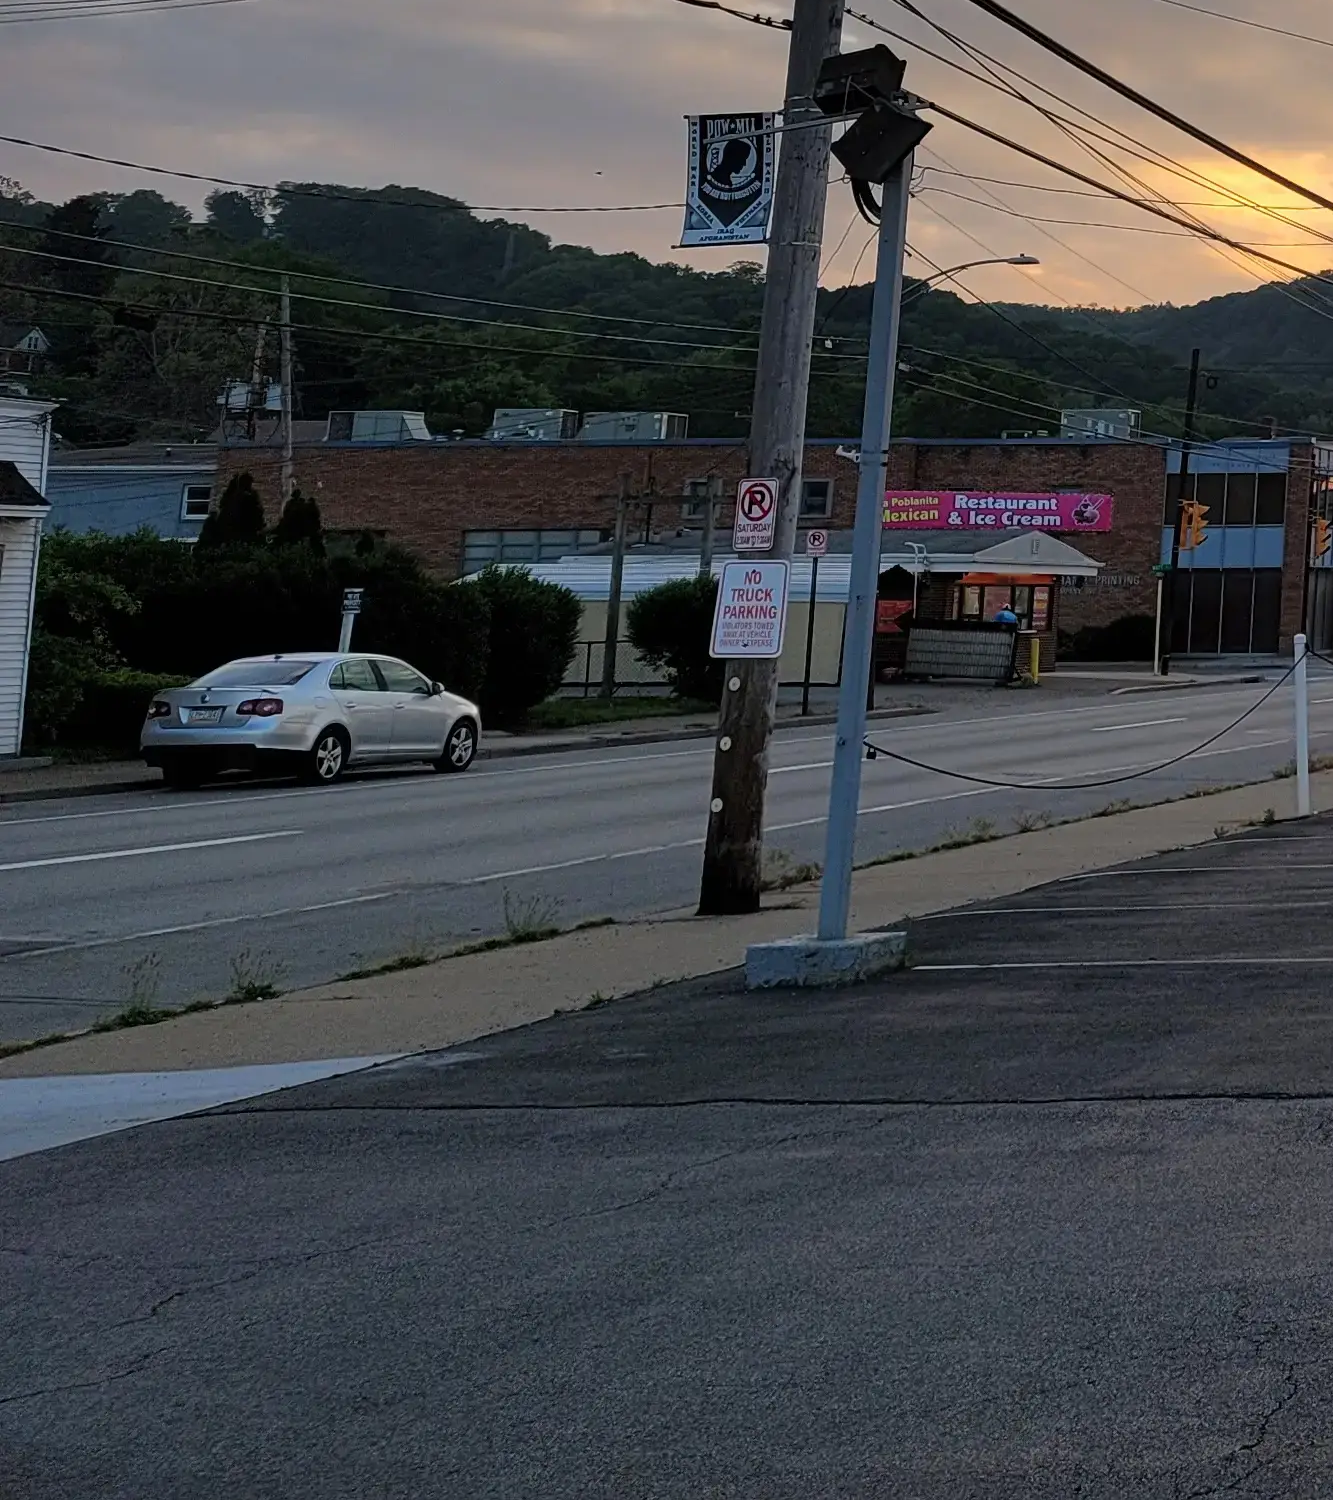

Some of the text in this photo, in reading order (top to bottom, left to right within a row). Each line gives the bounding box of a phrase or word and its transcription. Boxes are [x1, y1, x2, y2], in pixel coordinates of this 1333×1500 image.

[696, 204, 714, 225] KOREA
[699, 234, 750, 242] AFGHANISTAN
[891, 496, 939, 507] Poblanita
[954, 494, 1058, 511] Restaurant
[948, 510, 1061, 526] & Ice Cream
[737, 523, 771, 533] SATURDAY
[744, 571, 762, 585] NO
[1095, 575, 1140, 585] PRINTING
[731, 588, 774, 602] TRUCK
[722, 605, 778, 620] PARKING
[722, 622, 775, 630] VIOLATORS TOWED
